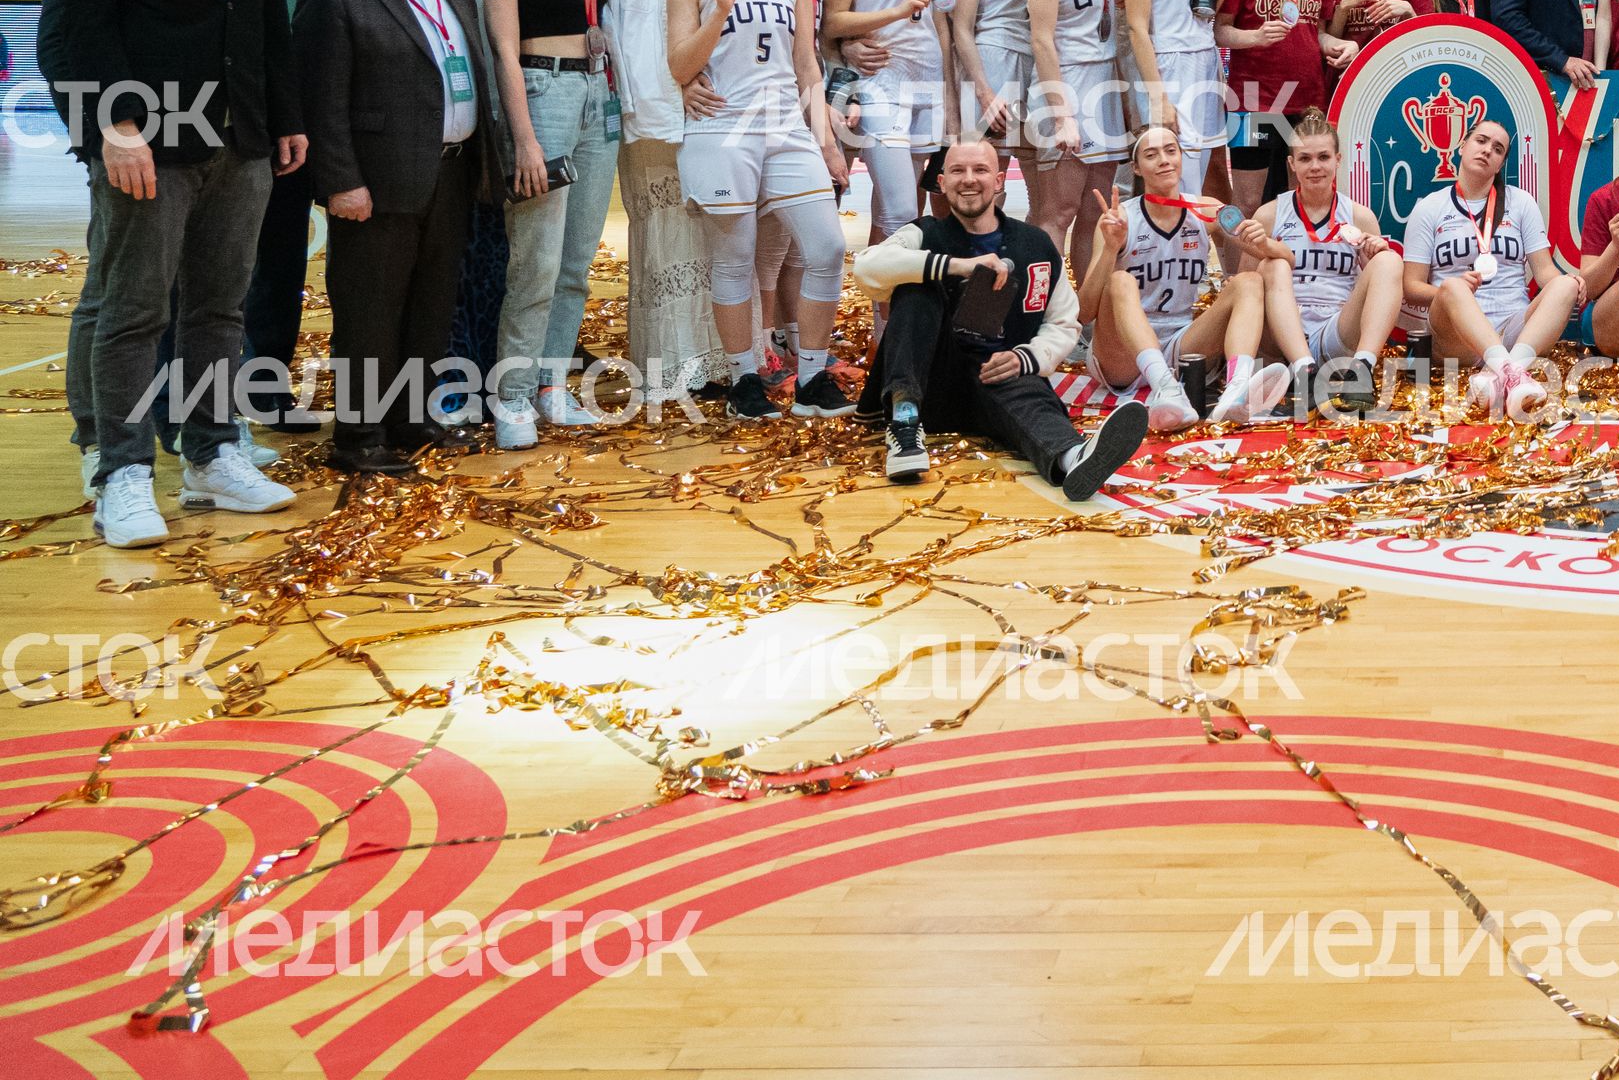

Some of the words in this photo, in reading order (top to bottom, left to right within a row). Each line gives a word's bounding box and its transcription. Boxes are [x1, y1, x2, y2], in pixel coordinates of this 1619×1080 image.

[756, 33, 772, 64] 5
[1410, 47, 1434, 63] ЛИГА
[1293, 249, 1355, 275] UTID
[1158, 288, 1174, 313] 2
